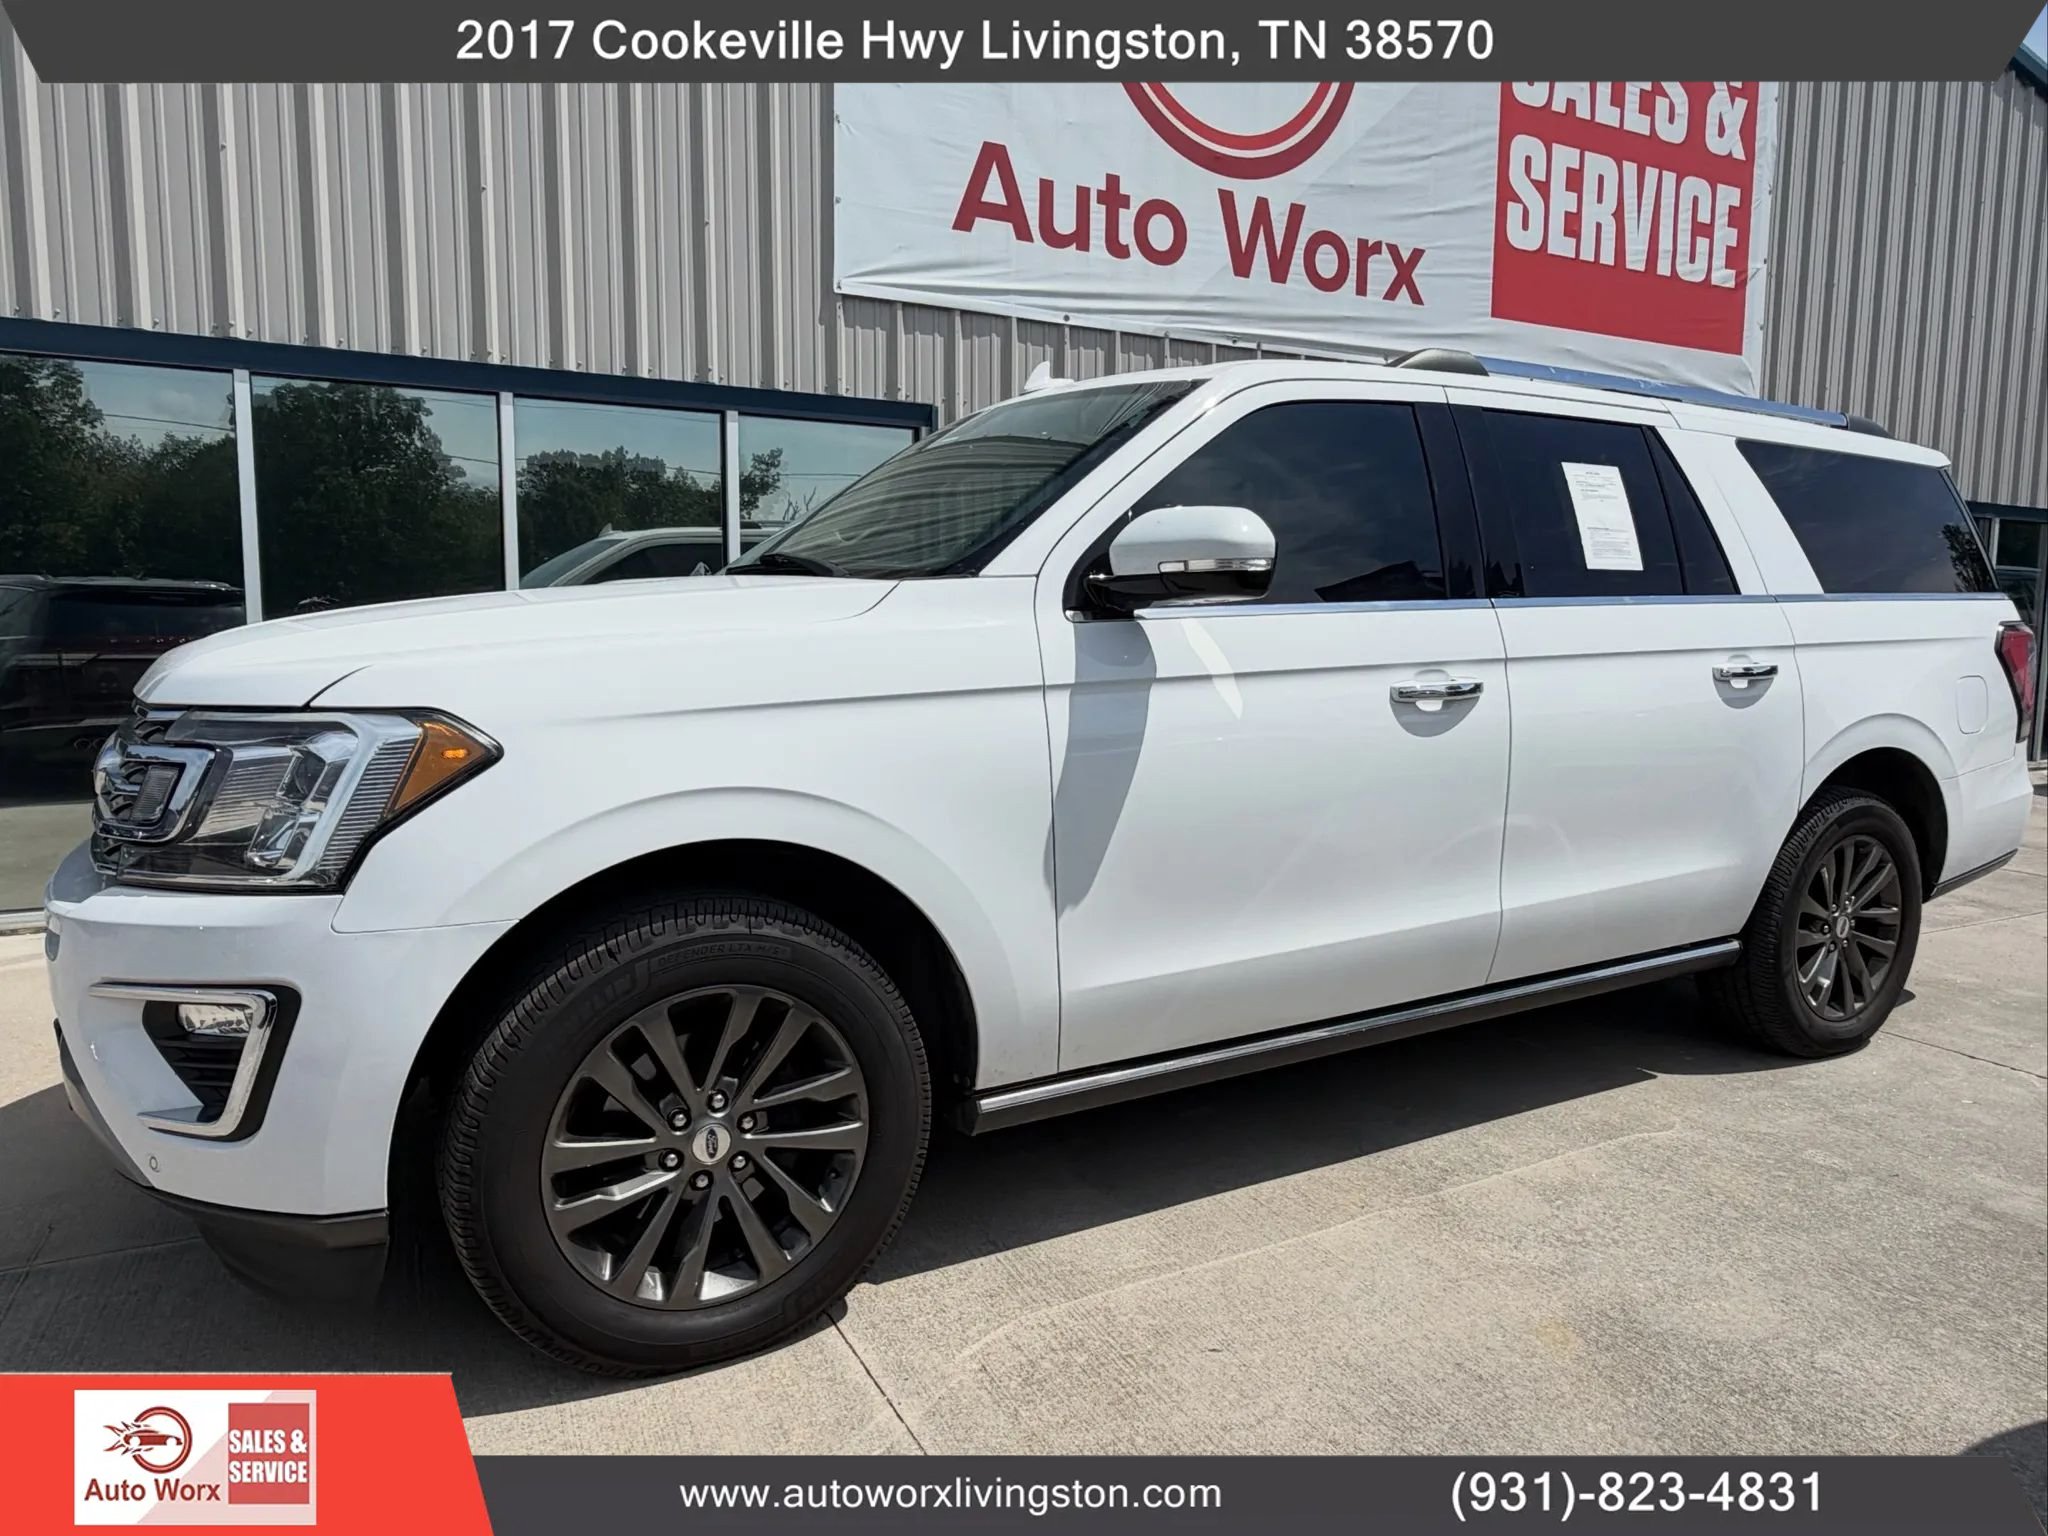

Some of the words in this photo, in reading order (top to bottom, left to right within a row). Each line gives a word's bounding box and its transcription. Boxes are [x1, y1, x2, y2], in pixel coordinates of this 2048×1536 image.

[951, 140, 1188, 266] Auto
[1217, 187, 1426, 307] Worx
[1506, 133, 1741, 288] SERVICE
[658, 943, 725, 965] DEFENDER
